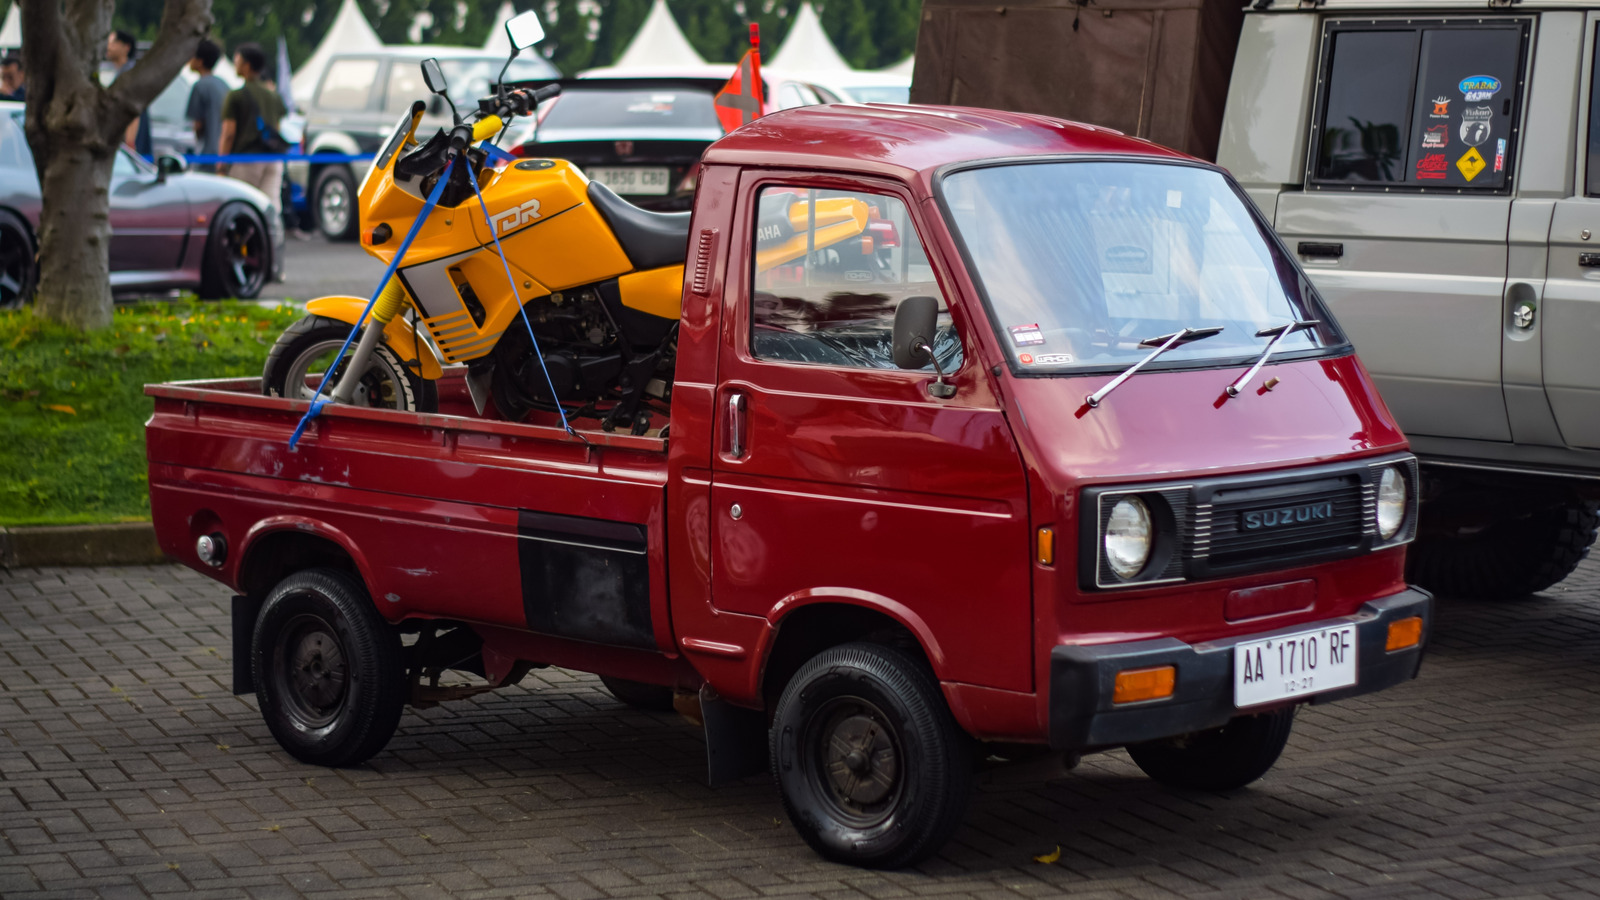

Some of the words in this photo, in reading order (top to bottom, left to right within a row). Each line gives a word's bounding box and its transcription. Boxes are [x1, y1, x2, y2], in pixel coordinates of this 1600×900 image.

[1463, 81, 1498, 90] TRABAS
[1425, 152, 1446, 162] LAND
[486, 198, 541, 235] TDR
[1246, 503, 1332, 529] SUZUKI
[1243, 646, 1264, 684] AA
[1278, 636, 1318, 675] 1710
[1330, 629, 1350, 665] RF
